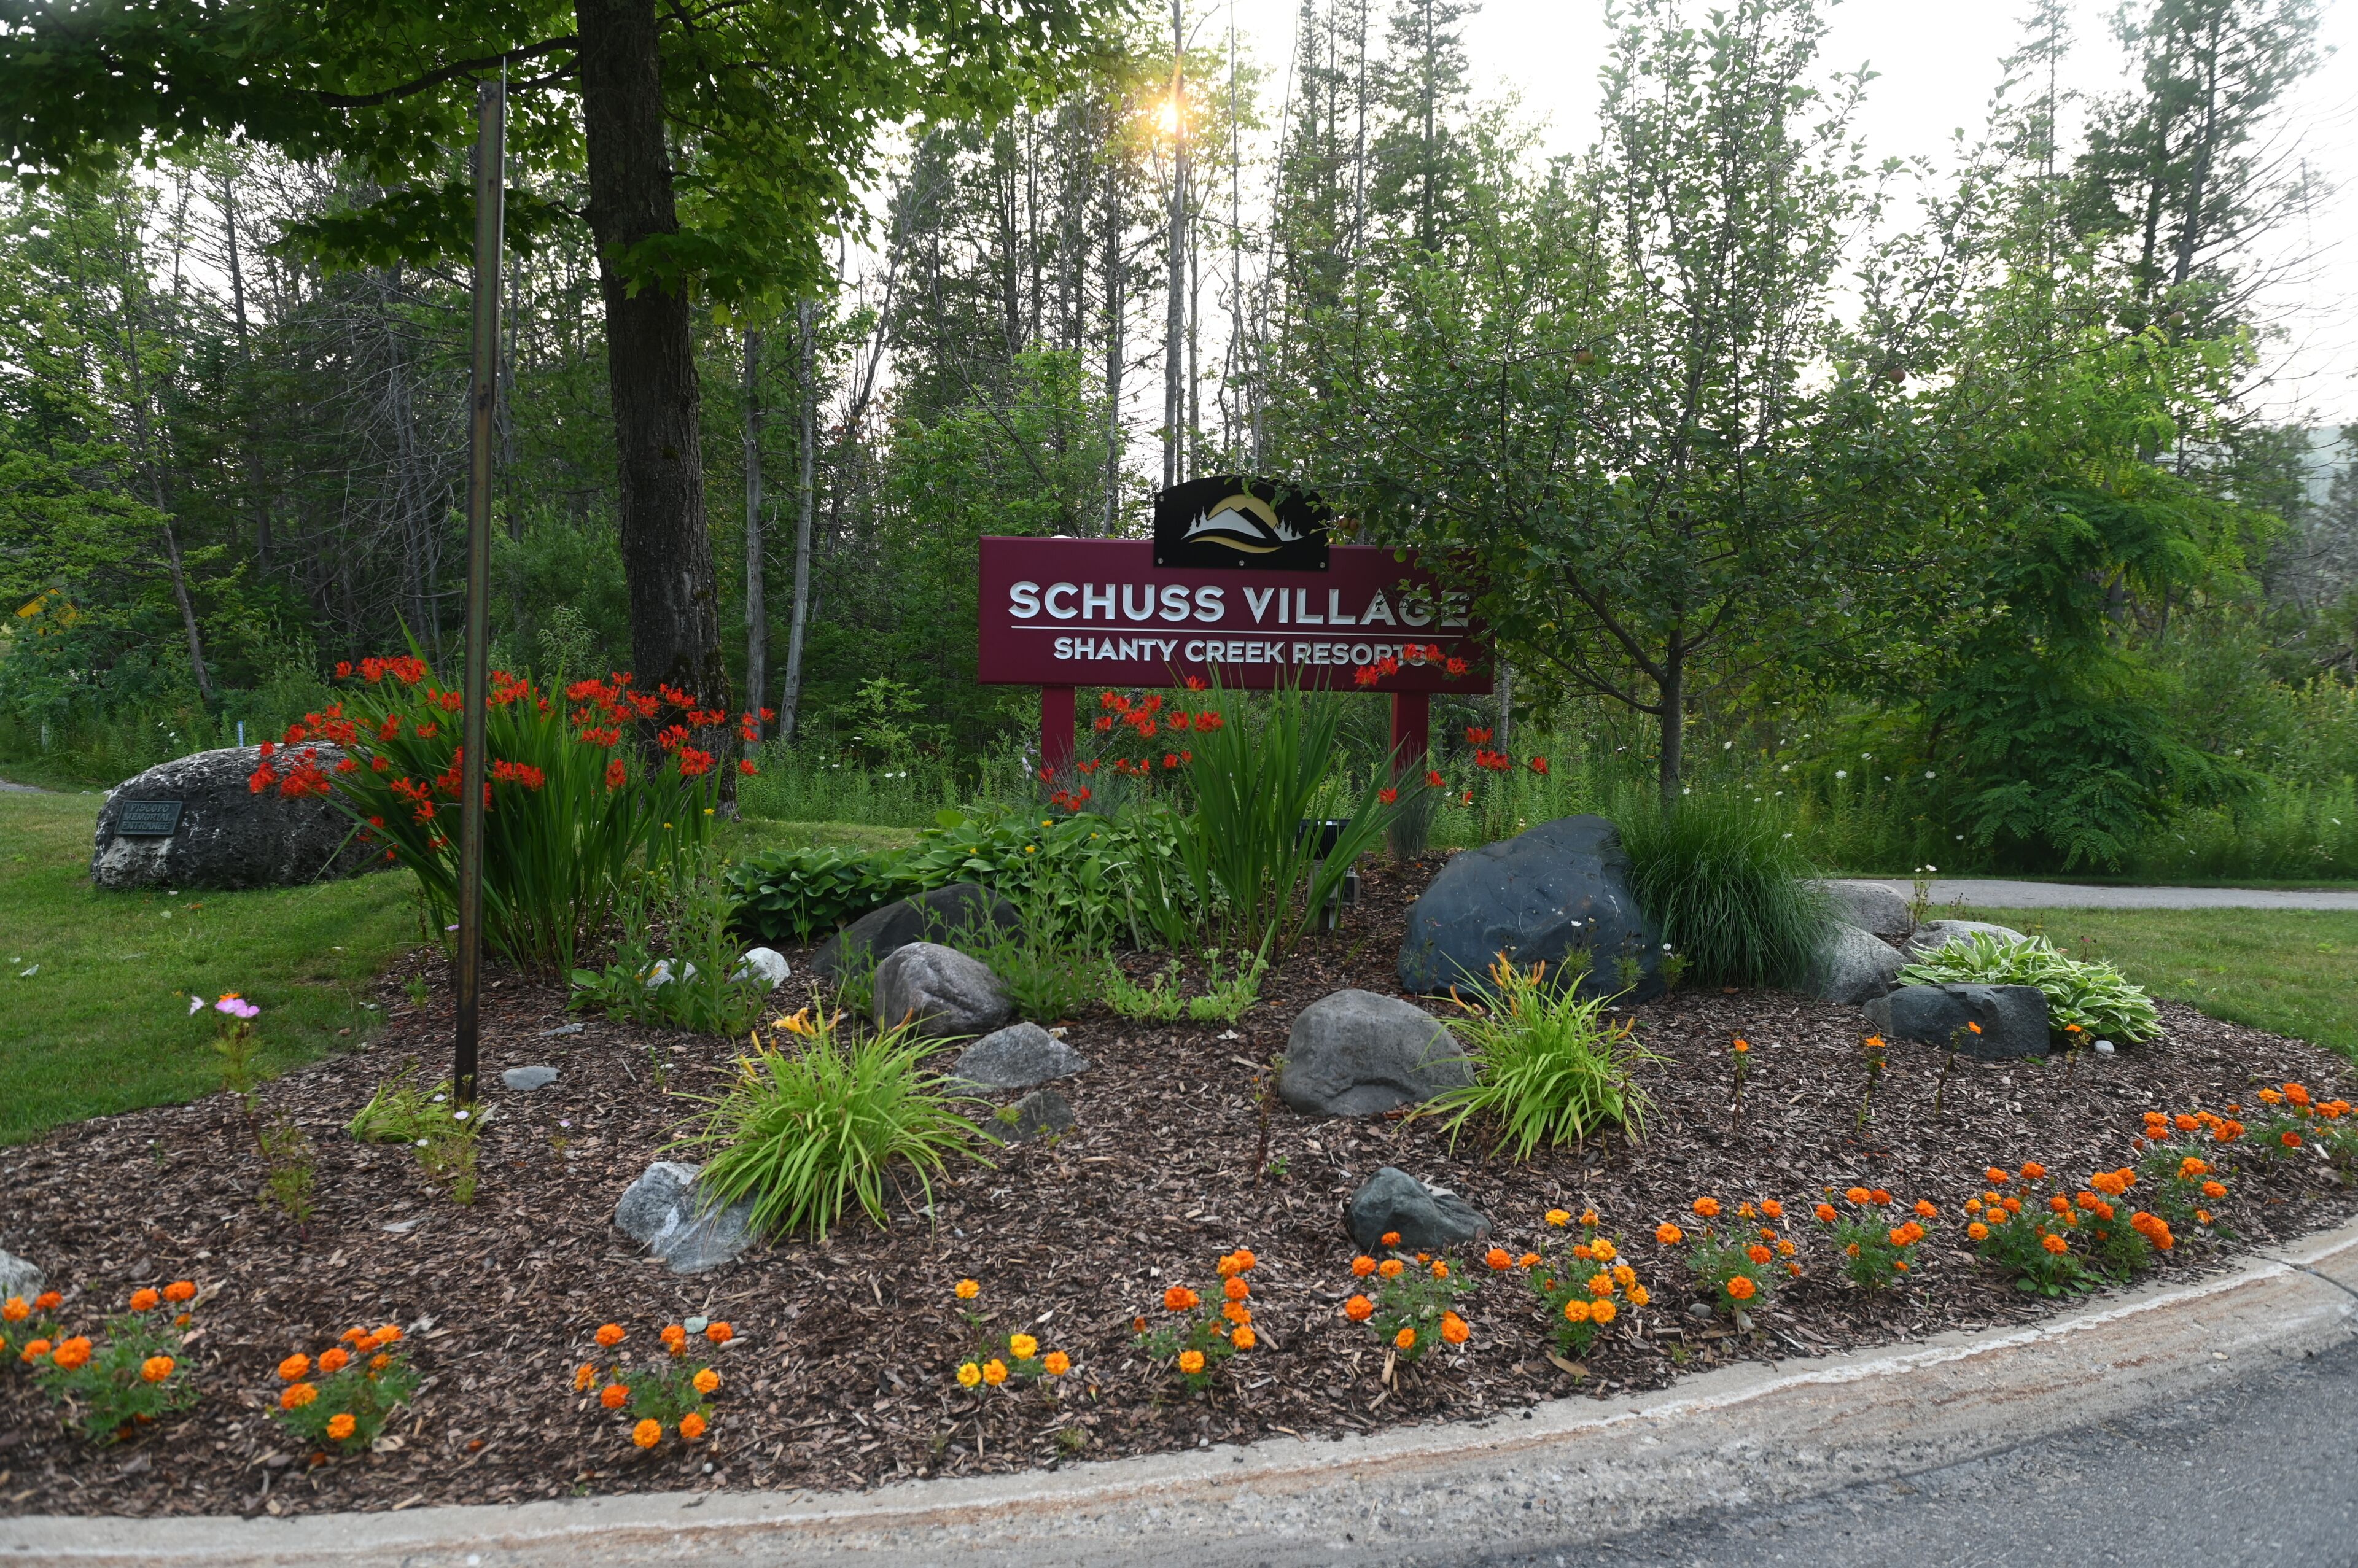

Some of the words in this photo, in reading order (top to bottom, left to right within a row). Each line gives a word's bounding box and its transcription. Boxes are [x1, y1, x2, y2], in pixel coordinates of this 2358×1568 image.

[1008, 581, 1225, 623] SCHUSS
[1242, 587, 1470, 627] VILLAGE
[1053, 637, 1178, 662] SHANTY
[1185, 639, 1286, 664] CREEK
[122, 821, 170, 830] ENTRANCE
[123, 813, 173, 821] MEMORIAL
